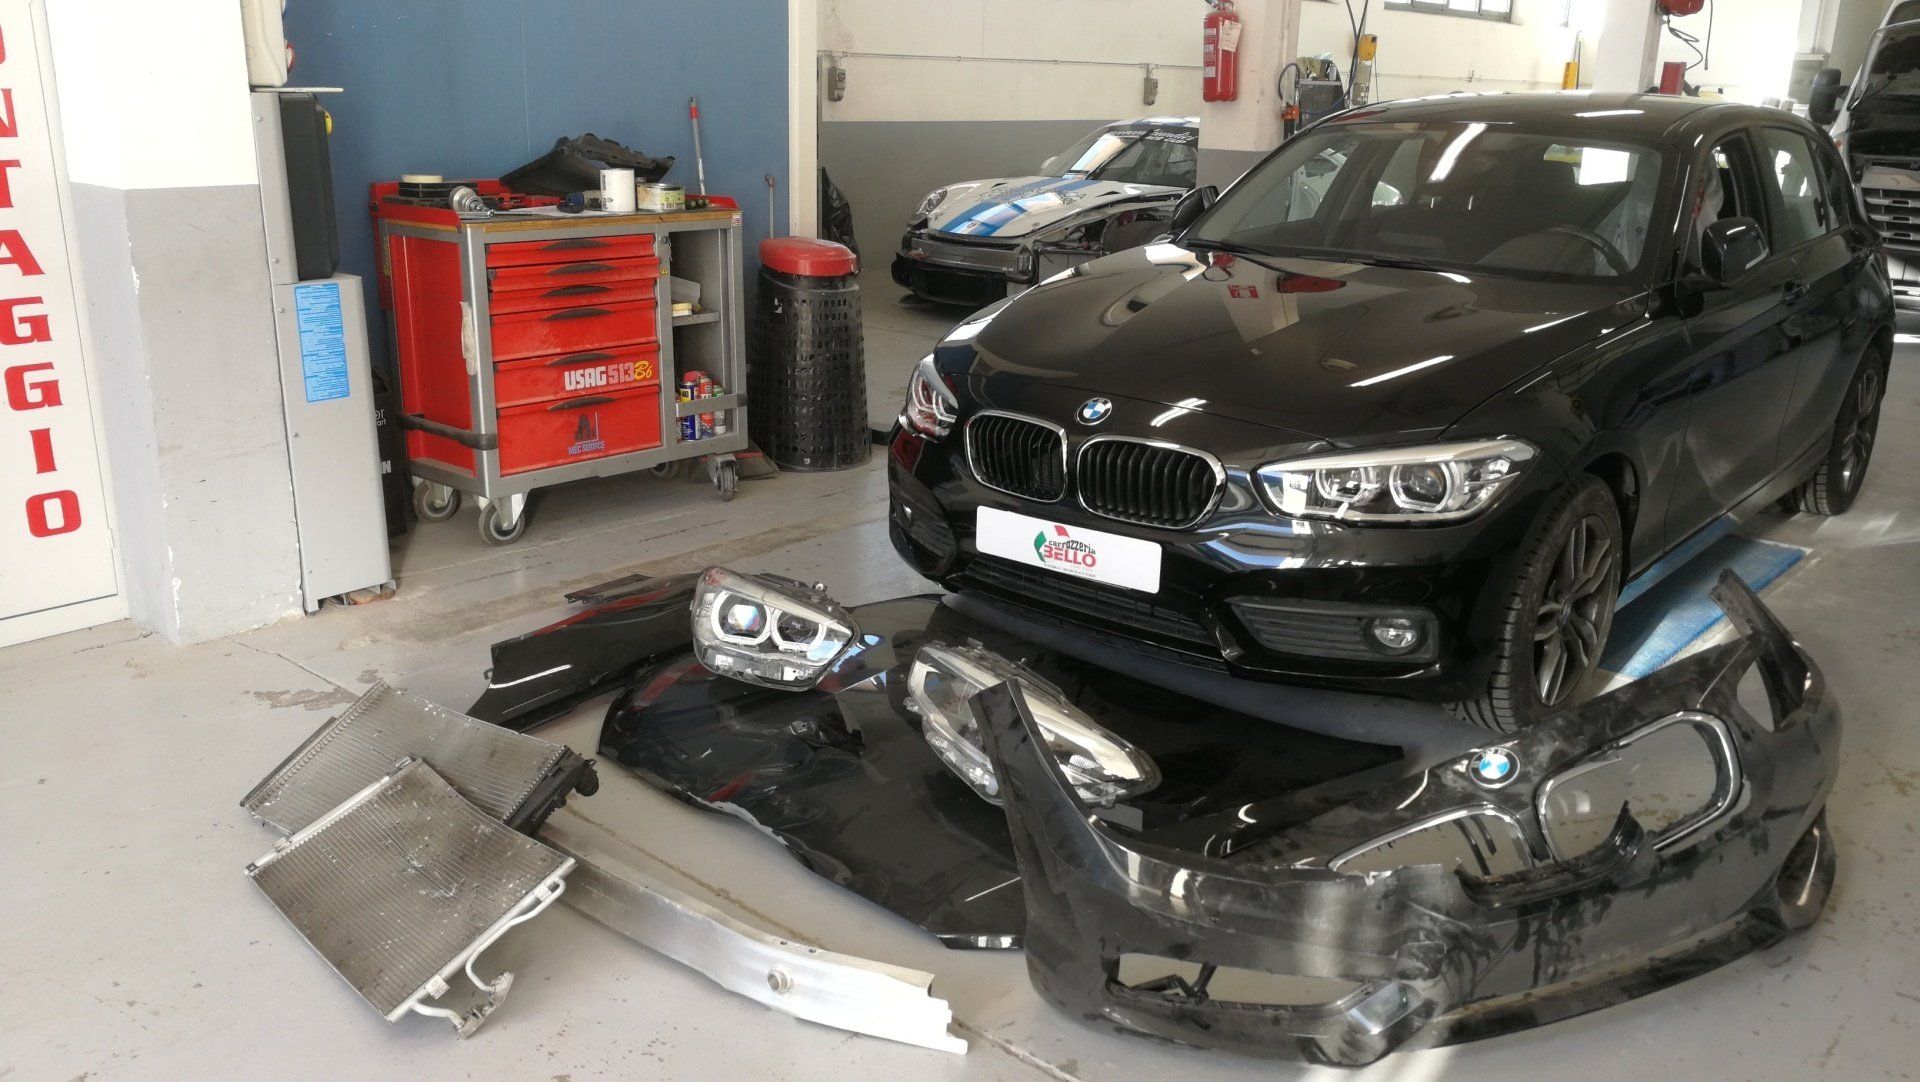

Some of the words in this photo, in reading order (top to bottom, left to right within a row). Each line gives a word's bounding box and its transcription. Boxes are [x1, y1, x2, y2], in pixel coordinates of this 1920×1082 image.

[564, 366, 607, 391] USAG
[1043, 544, 1097, 568] BELLO
[1048, 539, 1096, 555] carrozzeria
